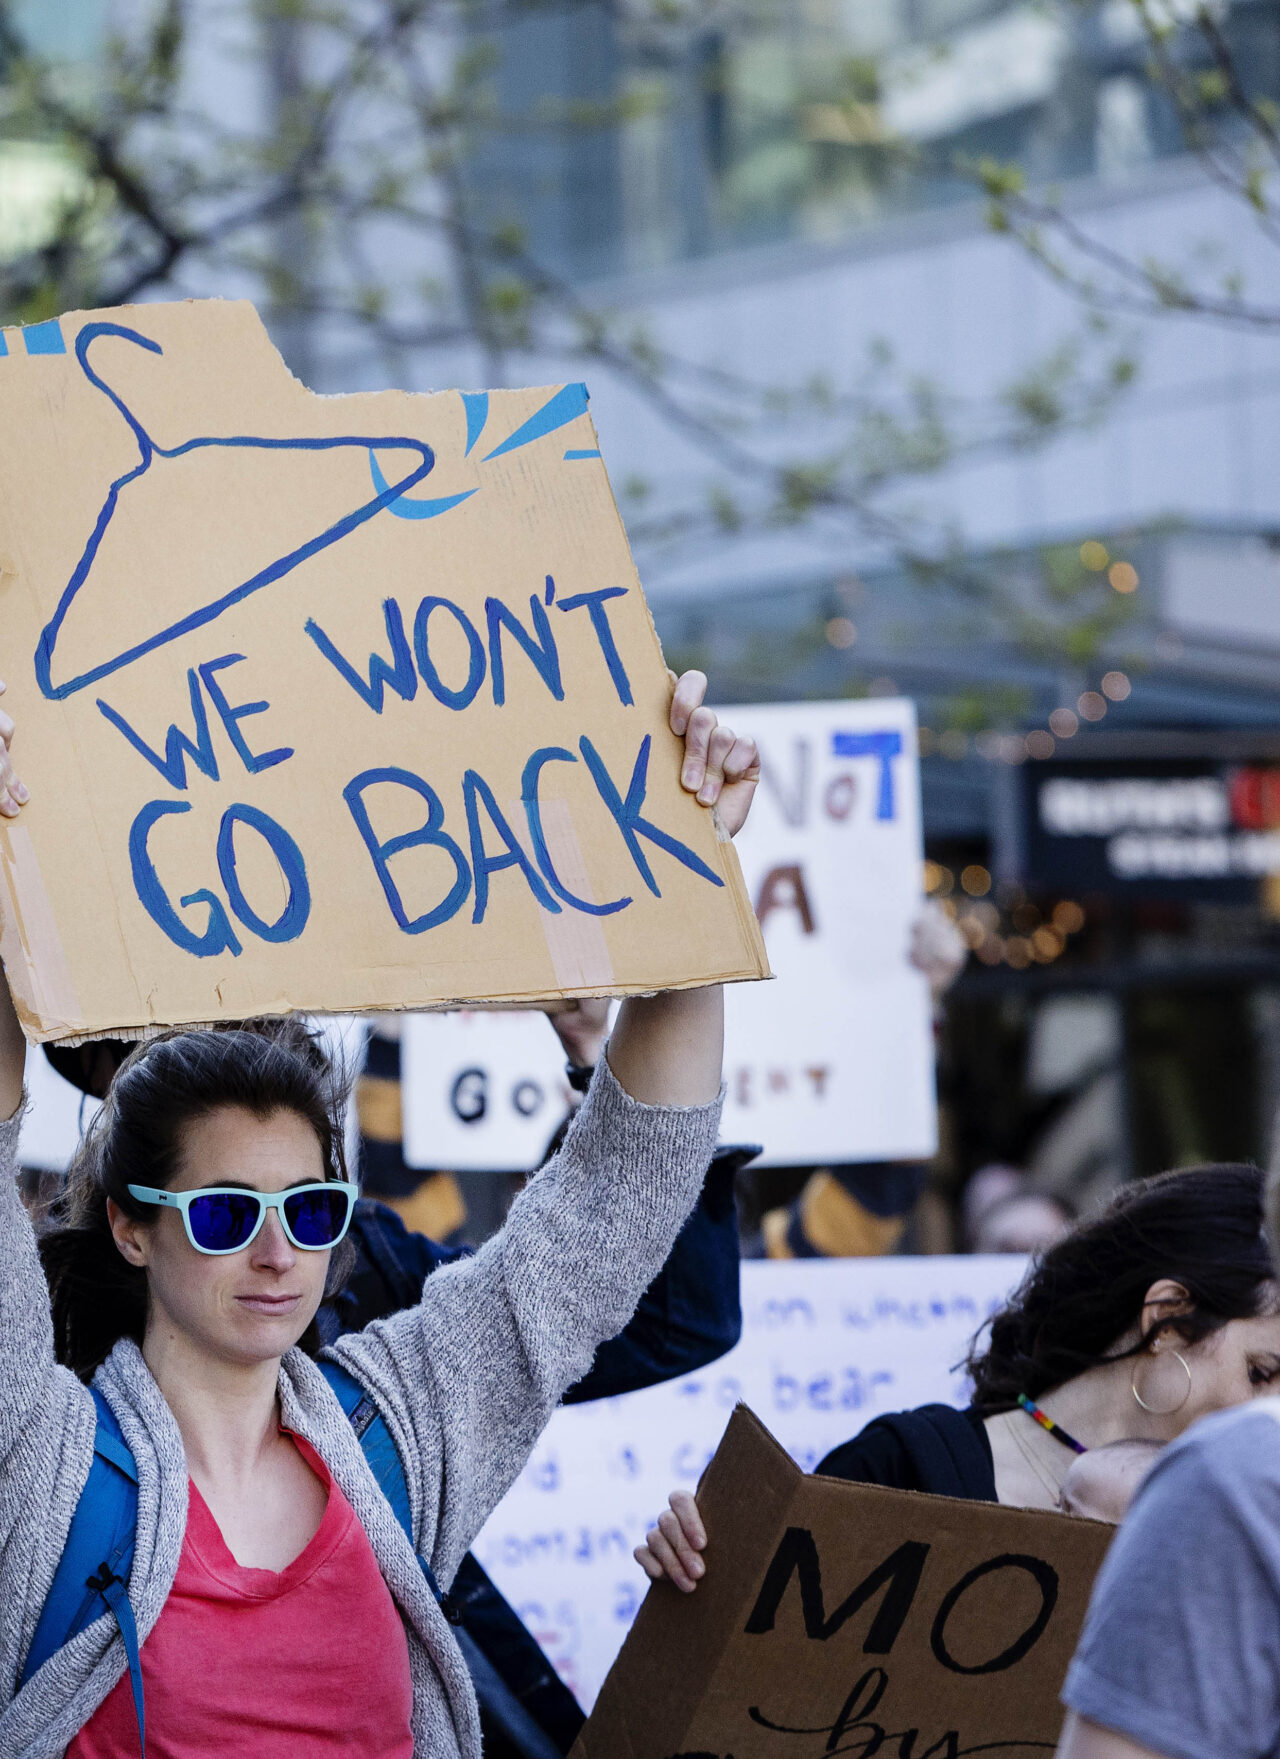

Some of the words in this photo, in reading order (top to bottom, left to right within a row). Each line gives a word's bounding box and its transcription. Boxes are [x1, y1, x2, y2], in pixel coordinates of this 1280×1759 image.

[96, 653, 295, 790] WE
[304, 574, 634, 714] WON'T
[128, 799, 312, 958] GO
[343, 734, 725, 935] BACK
